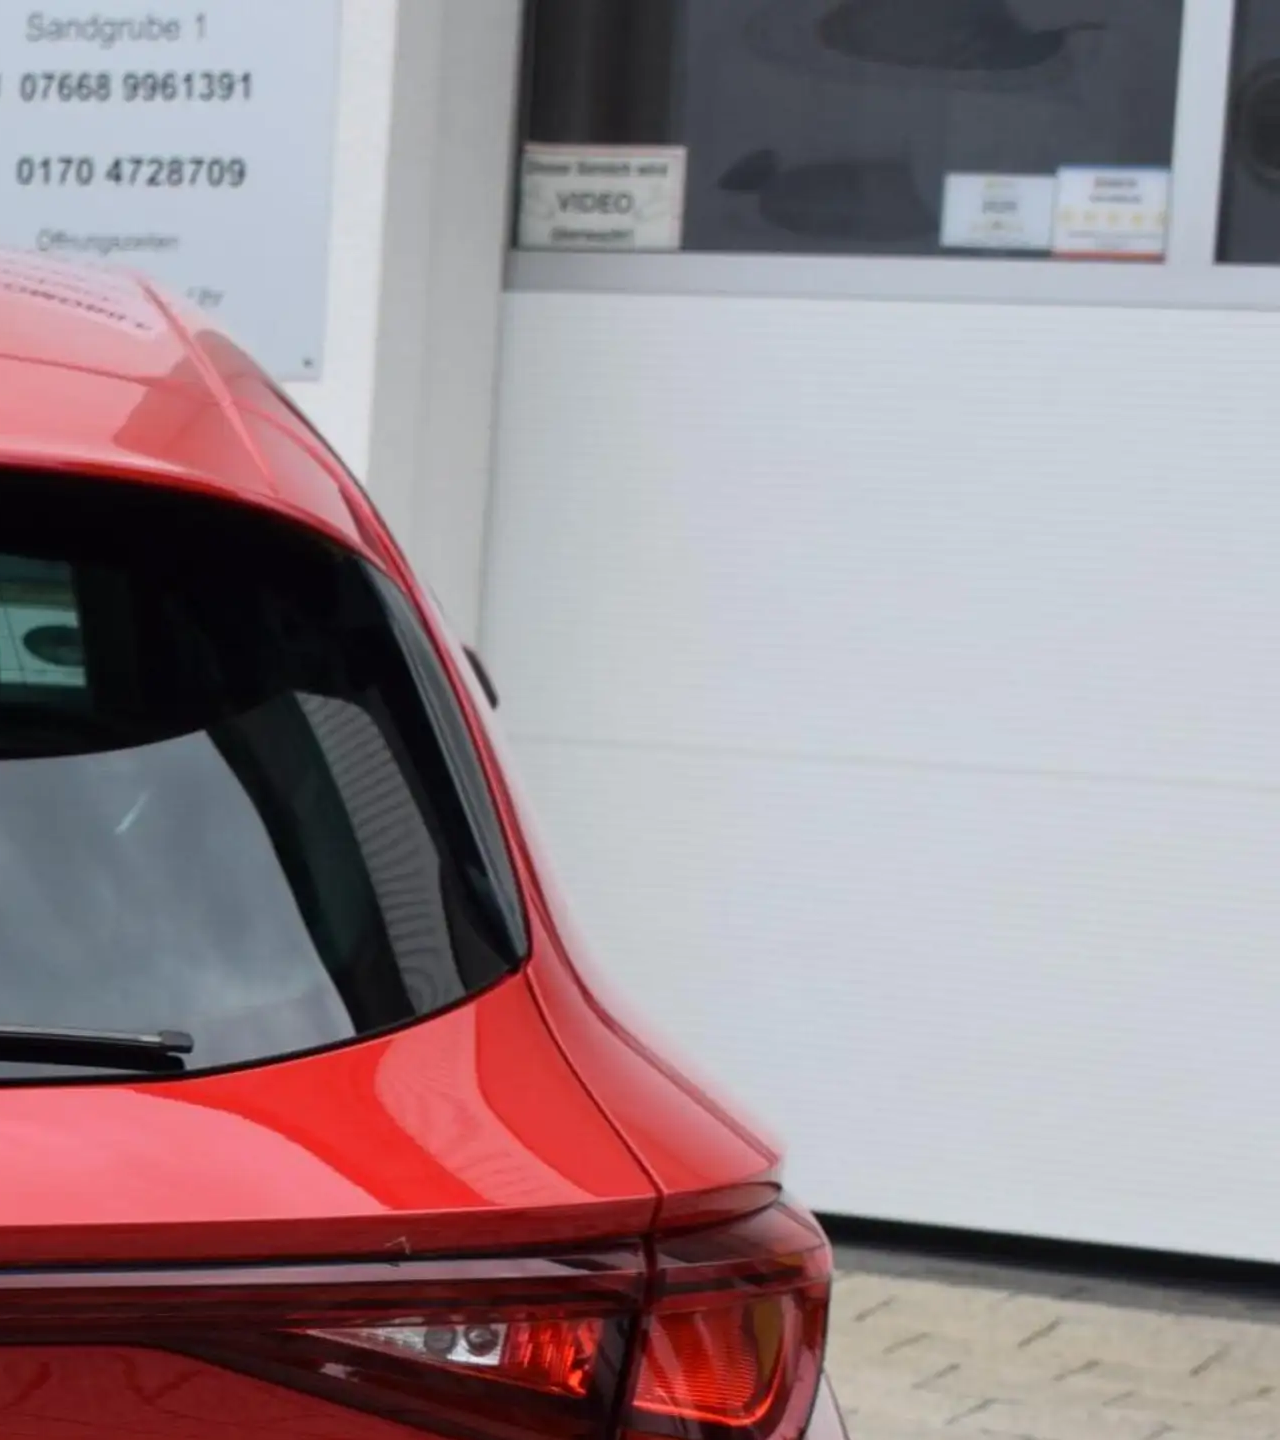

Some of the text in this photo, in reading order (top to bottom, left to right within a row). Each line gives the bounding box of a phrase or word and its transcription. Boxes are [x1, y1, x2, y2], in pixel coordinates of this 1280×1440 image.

[25, 11, 207, 49] Sandgrube 1
[19, 72, 112, 103] 07668
[122, 71, 253, 103] 9961391
[15, 156, 247, 188] 0170 4728709
